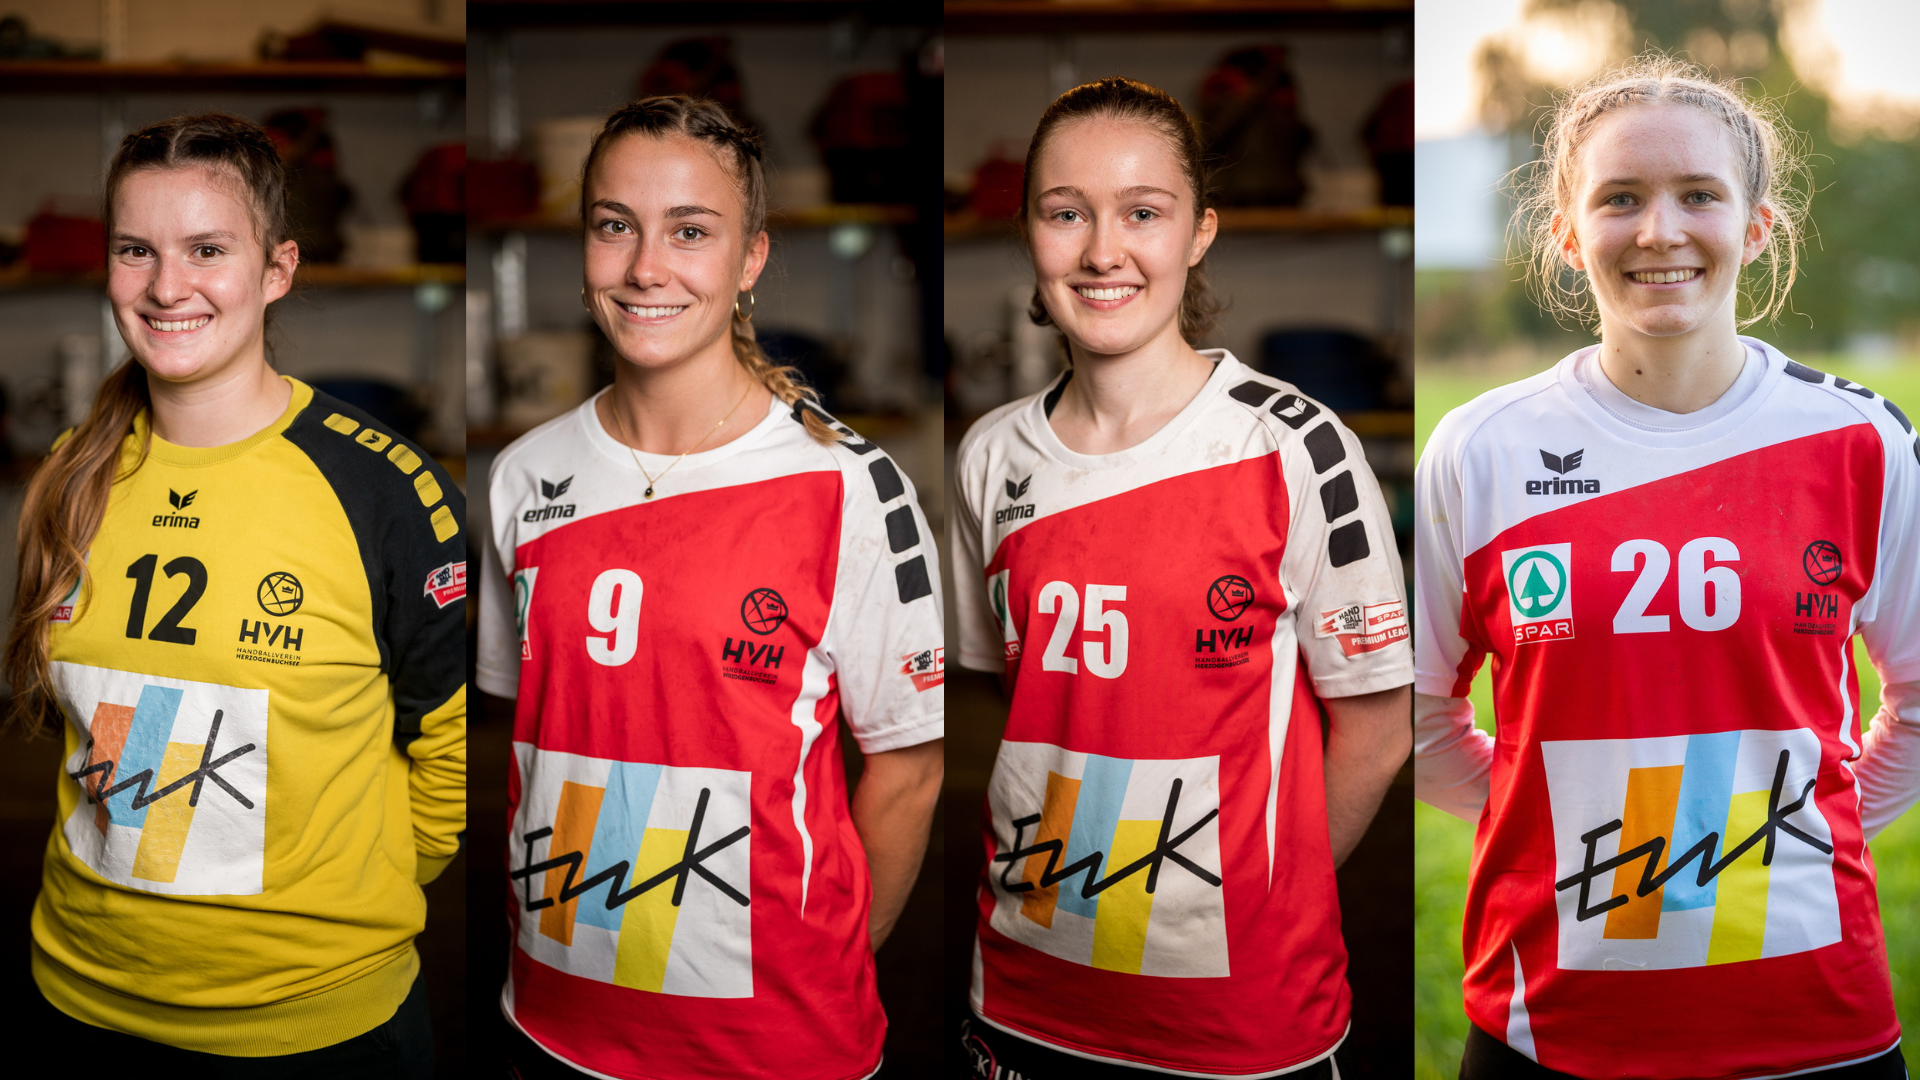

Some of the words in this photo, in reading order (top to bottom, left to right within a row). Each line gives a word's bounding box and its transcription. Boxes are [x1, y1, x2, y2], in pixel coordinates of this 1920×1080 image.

[1526, 477, 1600, 495] erima
[152, 511, 200, 529] erima
[523, 504, 576, 522] erima
[996, 504, 1035, 524] erima
[1610, 536, 1742, 635] 26
[125, 553, 208, 646] 12
[1795, 592, 1838, 618] HVH
[585, 568, 644, 667] 9
[1338, 605, 1360, 620] HAND
[1344, 614, 1362, 624] BALL
[239, 618, 304, 652] HVH
[1037, 580, 1129, 680] 25
[1196, 625, 1254, 653] HVH
[1516, 622, 1570, 641] SPAR
[1351, 633, 1387, 646] PREMIUM
[235, 653, 300, 667] HERZOGENBUCHSEE
[236, 647, 301, 661] HANDBALLVEREIN
[722, 637, 785, 669] HVH
[1195, 651, 1249, 663] HANDBALLVEREIN
[1194, 657, 1250, 669] HERZOGENBUCHSEE
[723, 666, 779, 679] HANDBALLVEREIN
